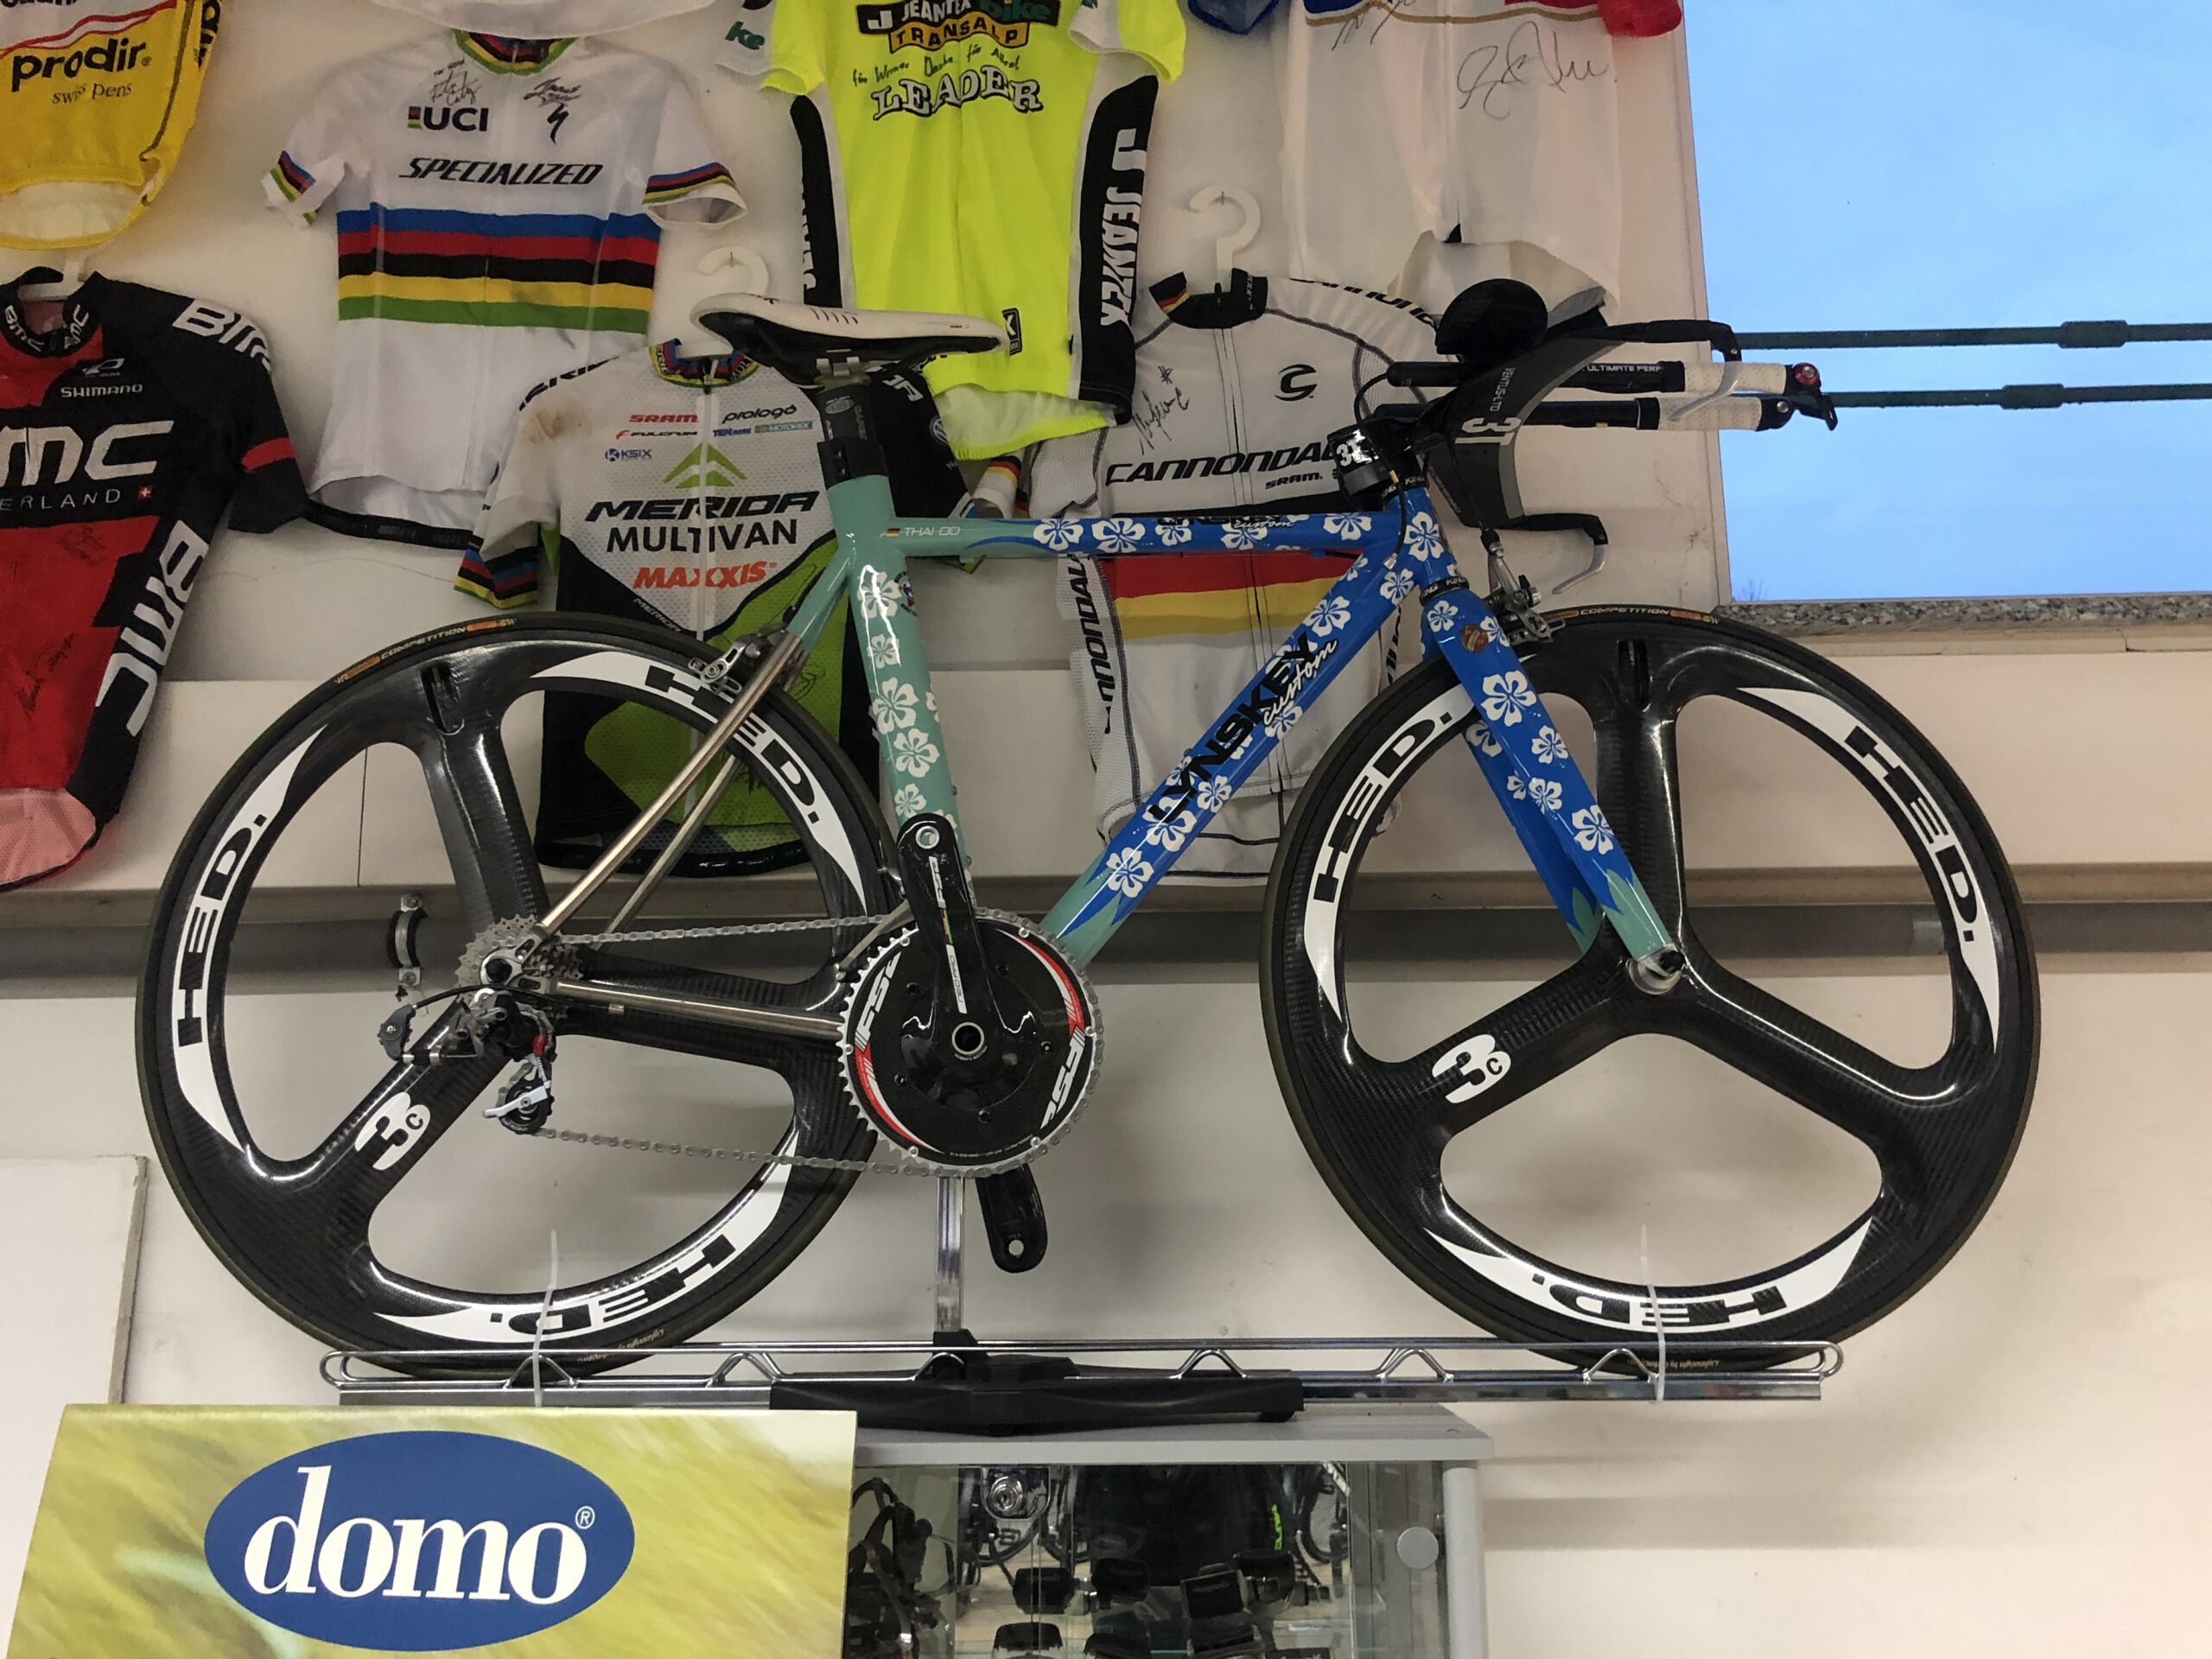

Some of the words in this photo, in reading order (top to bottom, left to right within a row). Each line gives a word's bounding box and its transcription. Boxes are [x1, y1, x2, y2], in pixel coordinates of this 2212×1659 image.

[895, 17, 1019, 47] TRANSALP
[871, 65, 1044, 120] LEADER
[423, 107, 490, 132] UCI
[398, 157, 604, 186] SPECIALIZED
[60, 384, 143, 398] SHIMANO
[629, 414, 697, 423] SRAM
[721, 404, 798, 424] prologo
[1105, 442, 1337, 486] CANNONDAL
[585, 491, 820, 522] MERIDA
[607, 519, 798, 554] MULTIVAN
[632, 561, 768, 589] MAXXIS
[1580, 607, 1670, 616] COMPETITION
[380, 626, 466, 659] COMPETITION
[1263, 639, 1338, 727] custom
[1147, 632, 1316, 822] LYNSKEY
